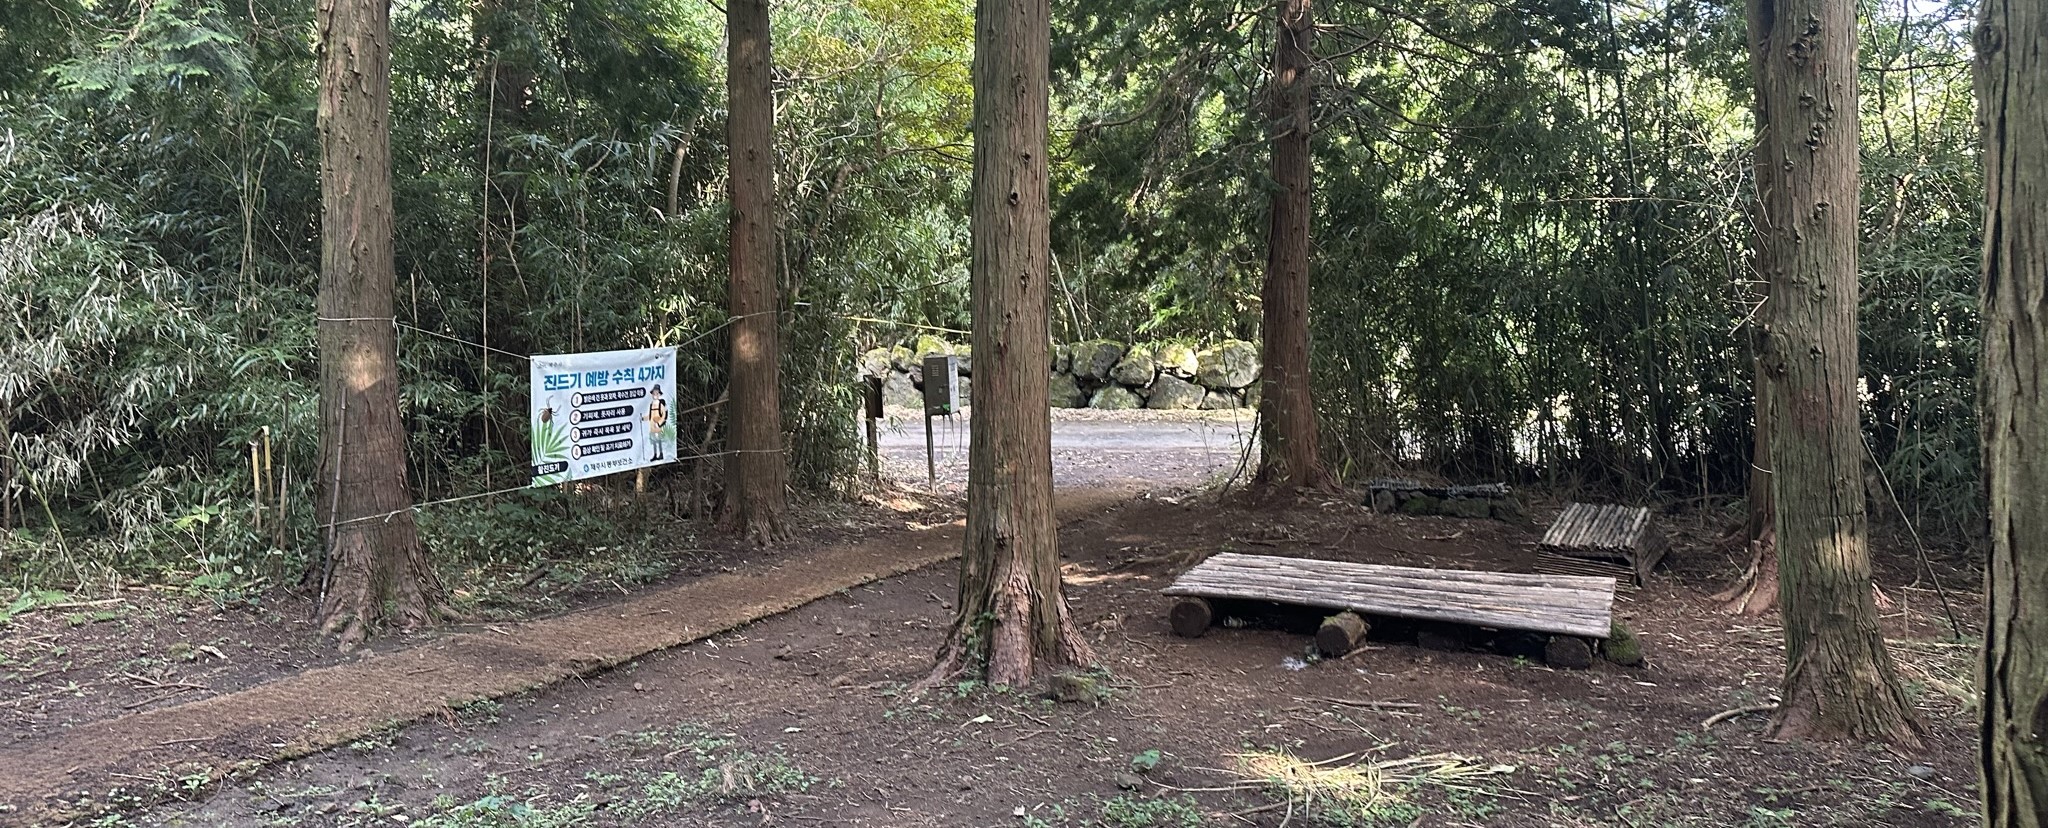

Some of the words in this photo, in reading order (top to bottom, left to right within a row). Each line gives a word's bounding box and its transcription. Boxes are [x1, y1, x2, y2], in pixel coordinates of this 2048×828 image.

[544, 372, 582, 391] 진드기
[585, 370, 609, 388] 예방
[612, 368, 635, 385] 수칙
[638, 365, 665, 382] 4가지
